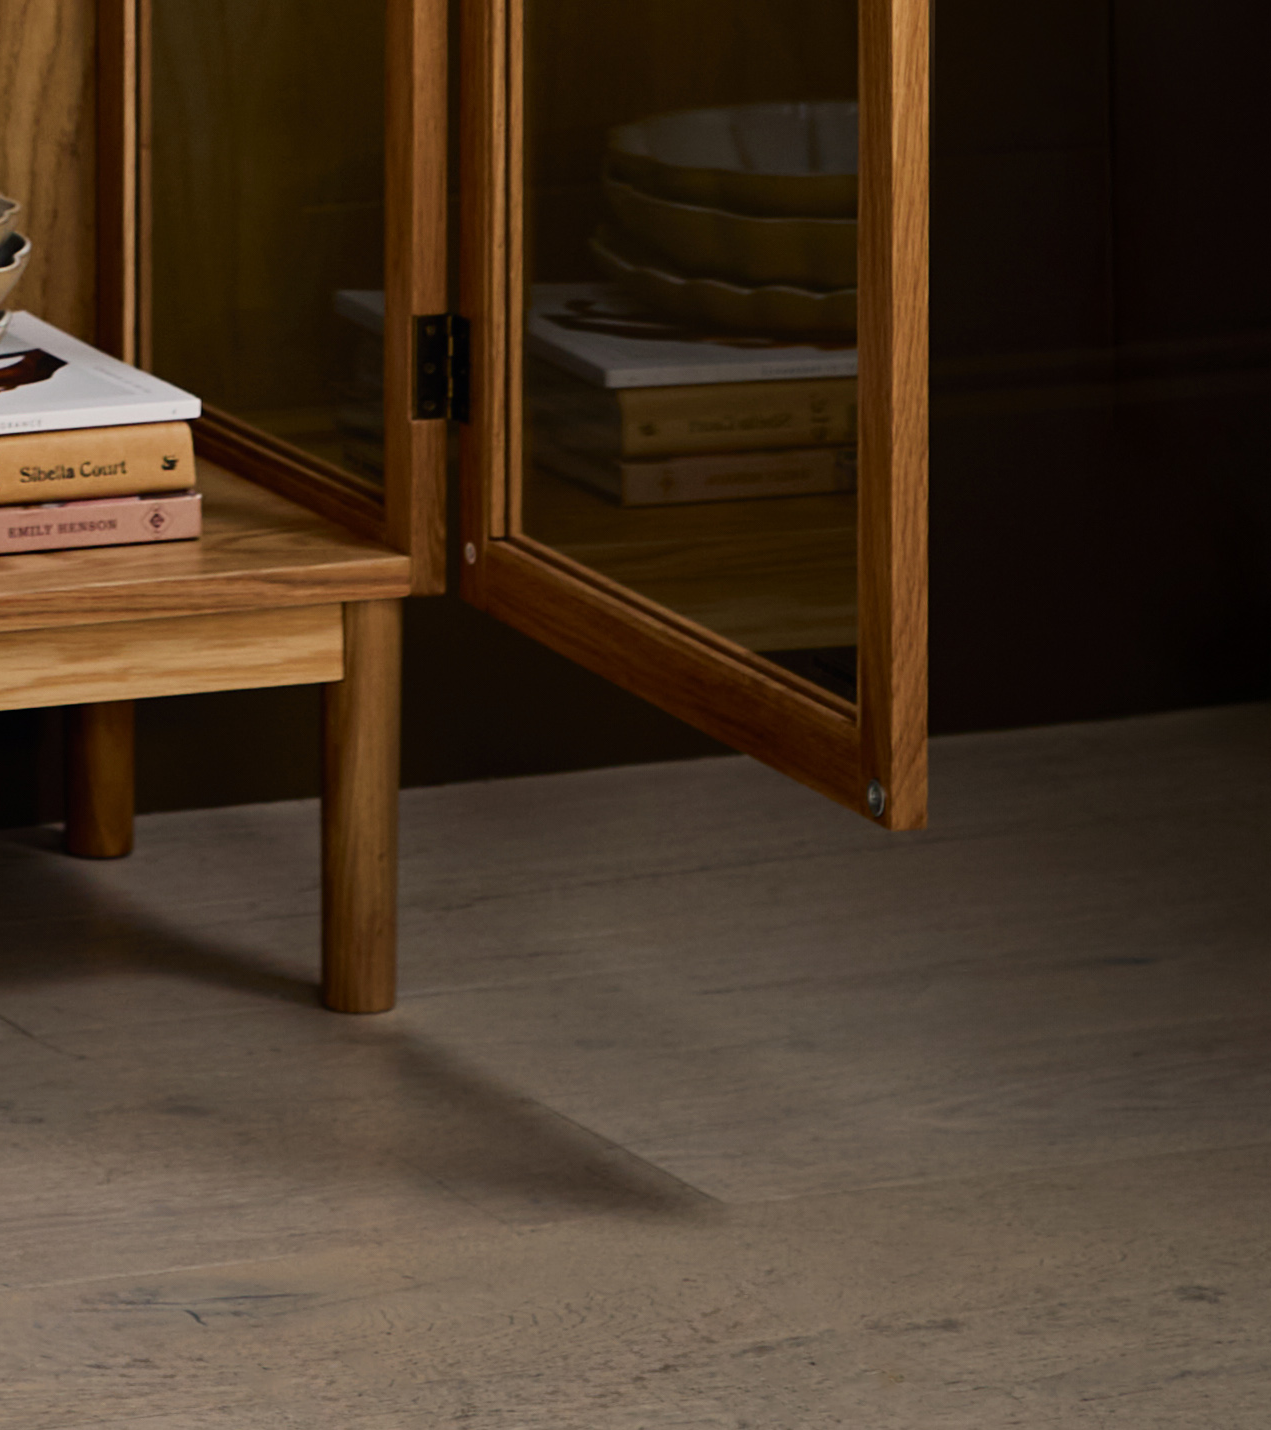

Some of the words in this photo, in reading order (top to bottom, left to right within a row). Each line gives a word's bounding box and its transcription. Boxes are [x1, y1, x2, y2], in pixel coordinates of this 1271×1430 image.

[19, 465, 76, 484] Sibella
[79, 460, 128, 478] Court
[8, 523, 54, 539] EMILY
[57, 518, 118, 535] HENSON
